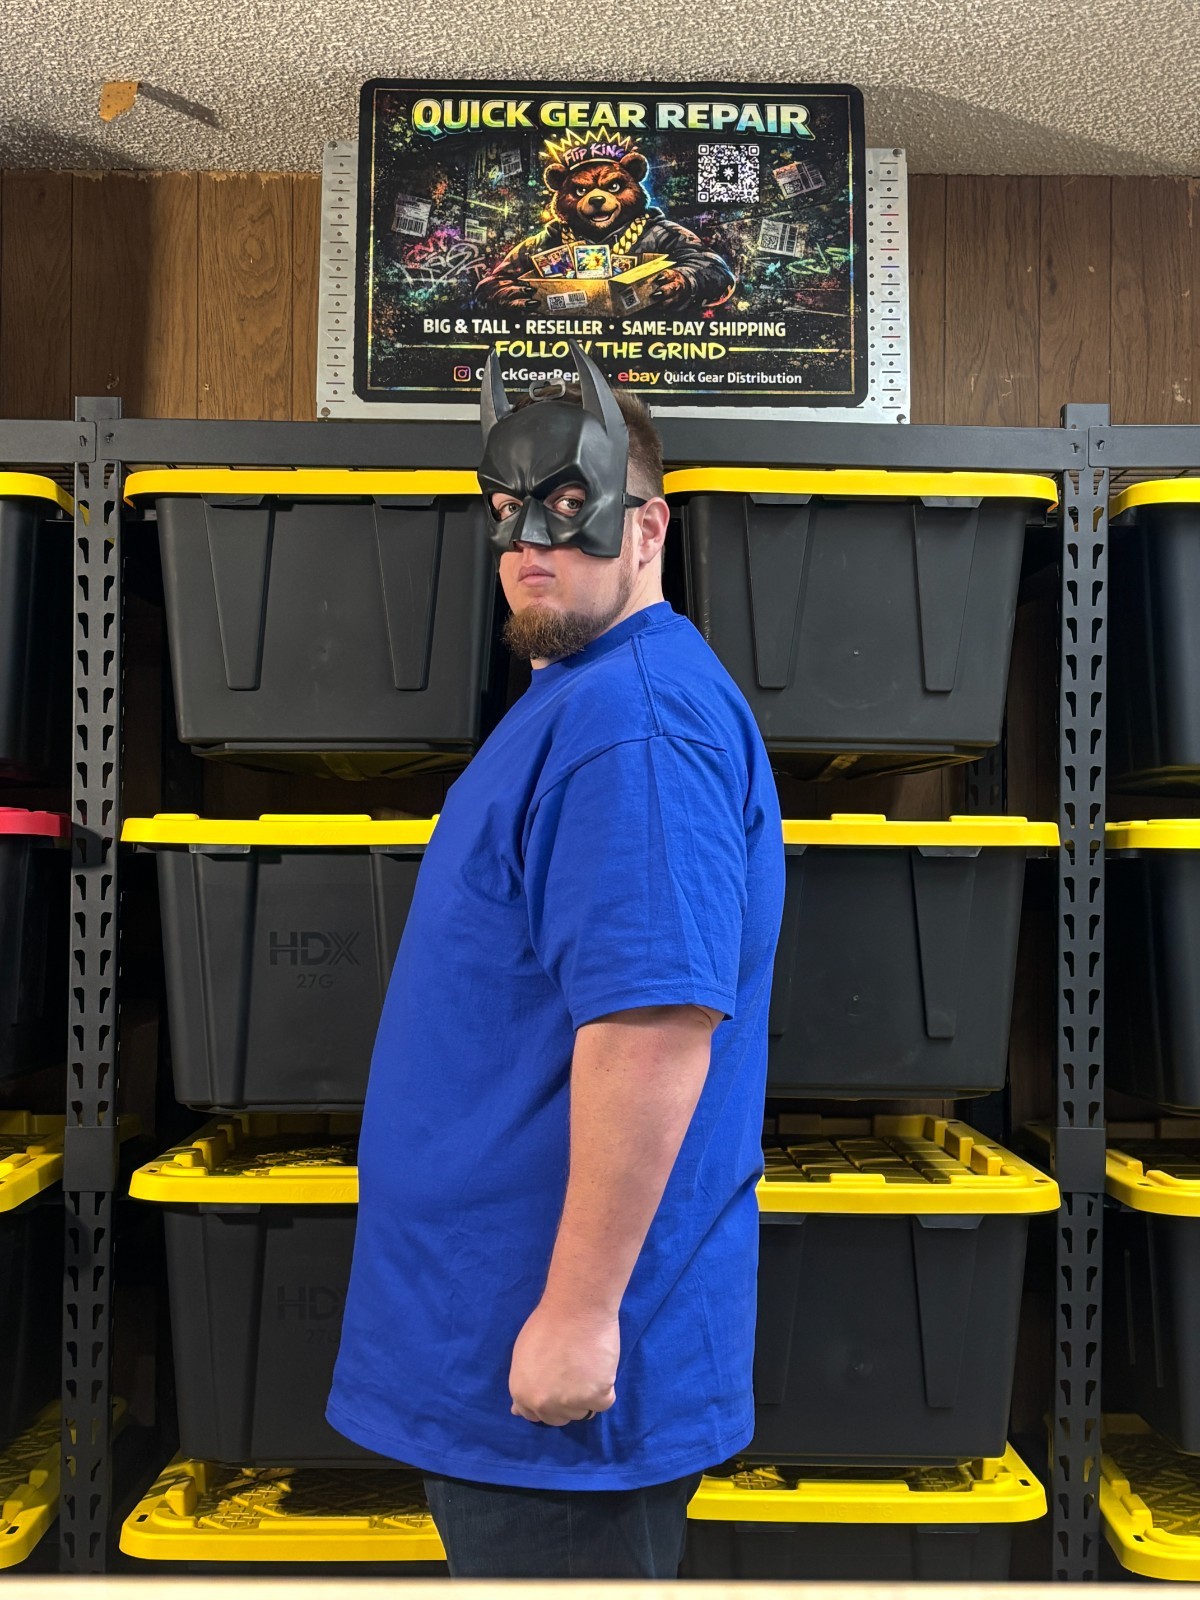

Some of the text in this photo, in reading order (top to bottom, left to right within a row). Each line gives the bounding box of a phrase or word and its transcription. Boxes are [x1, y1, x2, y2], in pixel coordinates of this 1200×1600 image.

[412, 99, 815, 140] QUICK GEAR REPAIR
[423, 318, 786, 337] BIG & TALL RESELLER SAME-DAY SHIPPING
[595, 341, 643, 359] THE
[647, 341, 727, 360] GRIND
[617, 368, 660, 384] ebay
[663, 371, 696, 385] Quick
[698, 371, 725, 383] Gear
[727, 372, 803, 384] Distribution
[269, 931, 361, 966] HDX
[296, 973, 334, 989] 27G
